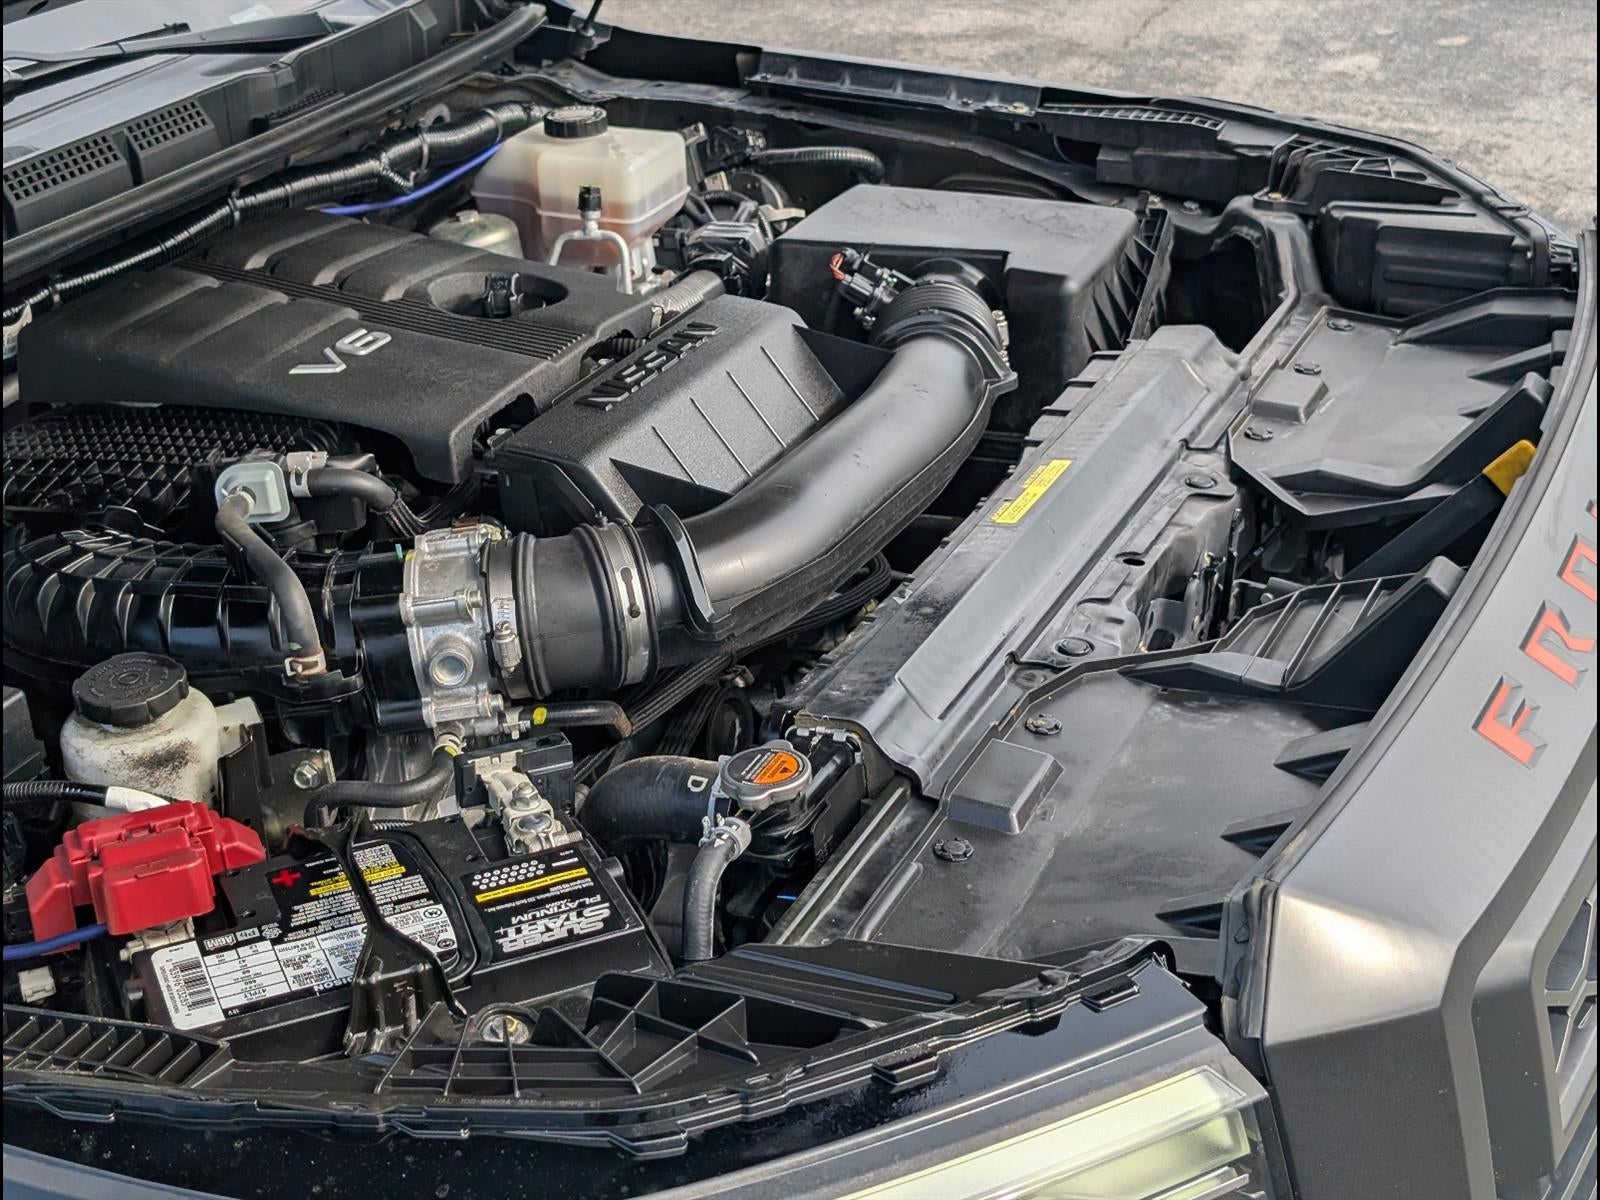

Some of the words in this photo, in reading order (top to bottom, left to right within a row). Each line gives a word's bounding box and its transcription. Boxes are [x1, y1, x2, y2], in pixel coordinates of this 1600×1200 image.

[288, 327, 393, 374] V6
[573, 321, 721, 411] NISSAN
[496, 903, 610, 944] START
[511, 895, 600, 924] PLATINUM
[206, 935, 232, 949] AGM
[239, 929, 255, 938] Pb
[501, 919, 605, 953] SUPER
[242, 987, 267, 998] 47PLT
[227, 1007, 239, 1015] 12V
